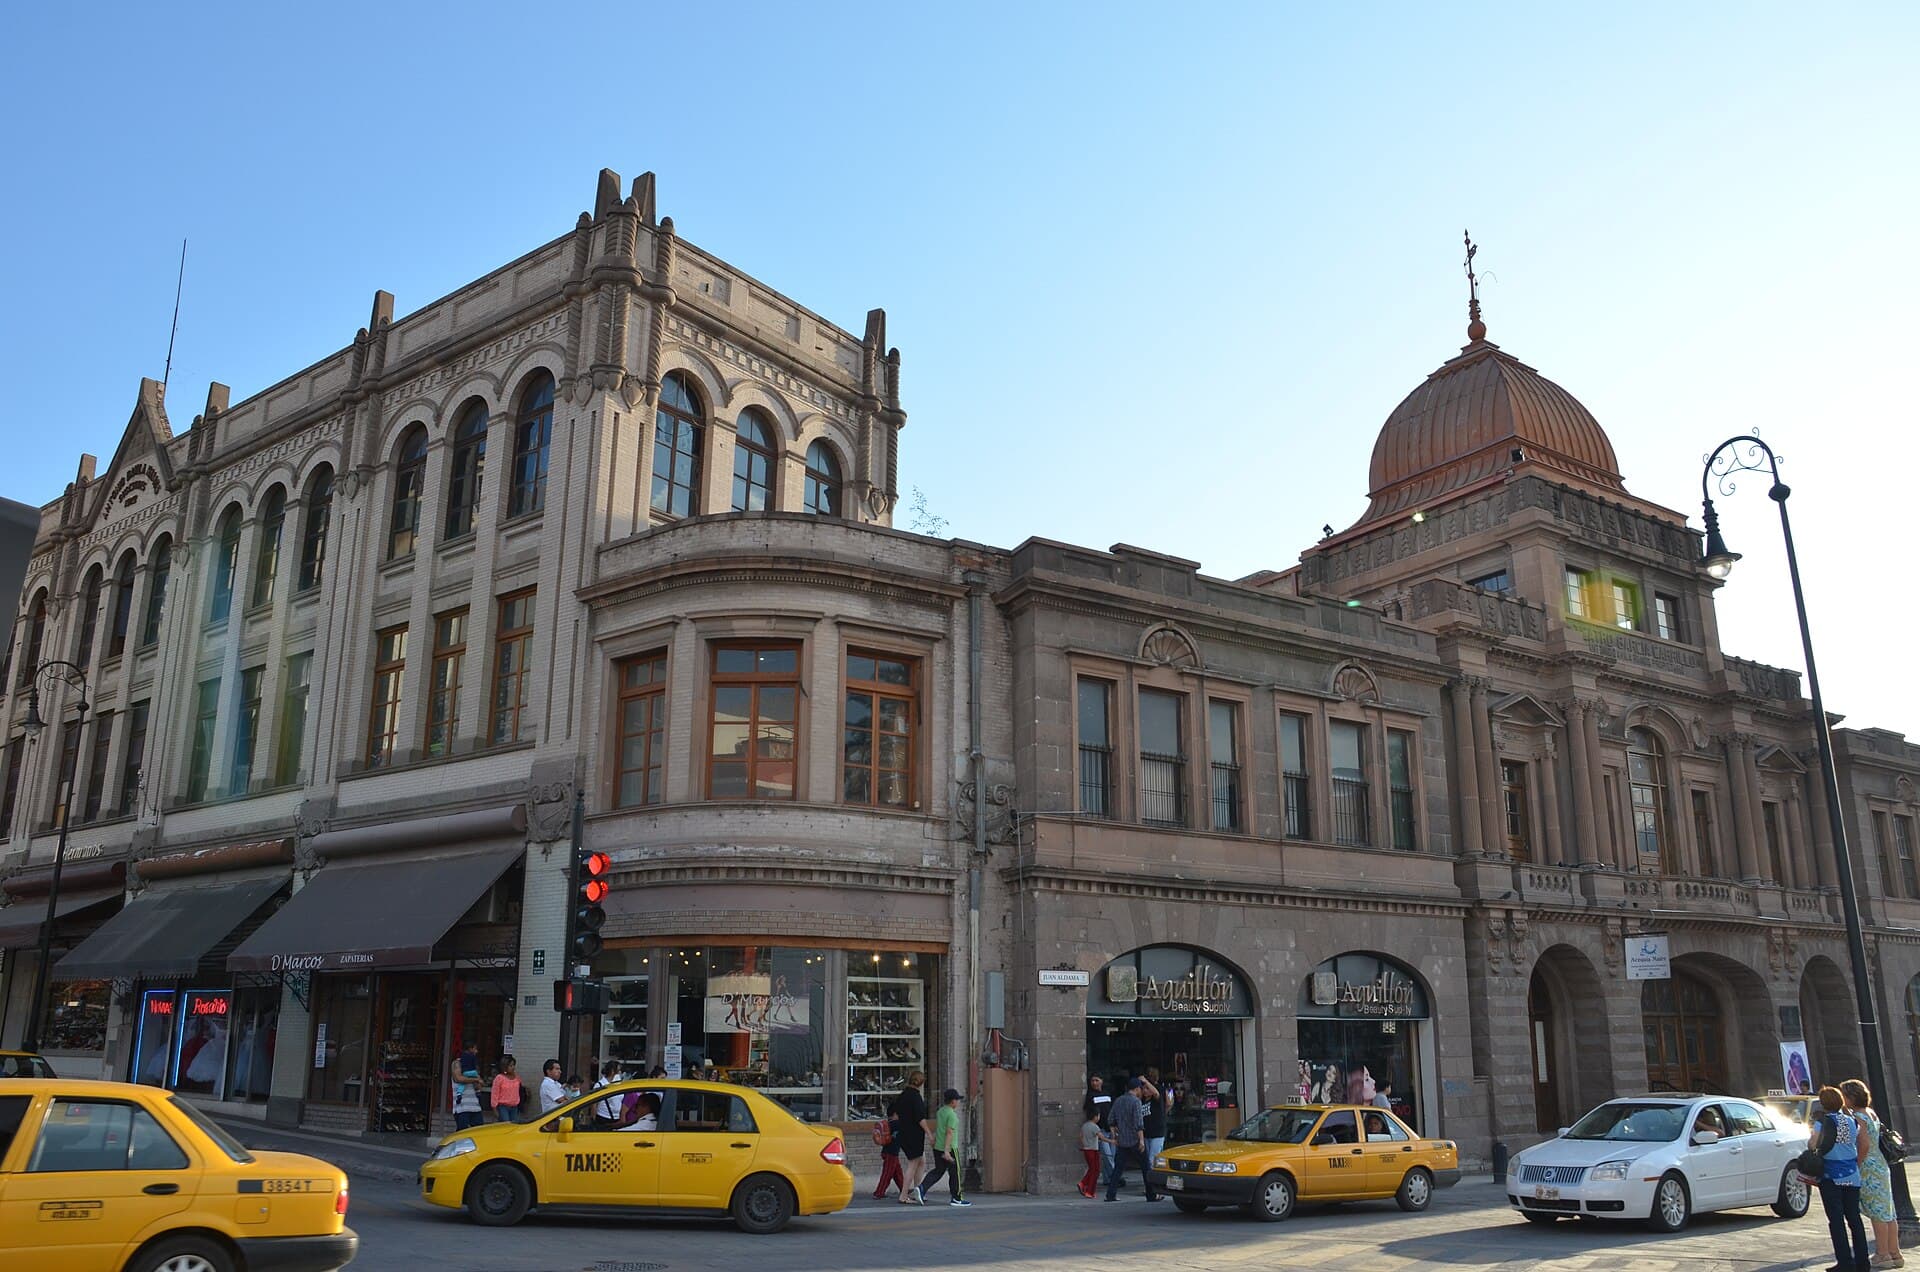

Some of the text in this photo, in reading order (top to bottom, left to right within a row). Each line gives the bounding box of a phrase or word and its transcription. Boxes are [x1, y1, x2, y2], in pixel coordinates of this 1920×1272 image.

[271, 954, 324, 971] D'Marcos
[1171, 1001, 1232, 1014] Beauty Supply
[1287, 1096, 1300, 1105] TAXI
[565, 1153, 601, 1172] TAXI
[1328, 1157, 1345, 1169] TAXI
